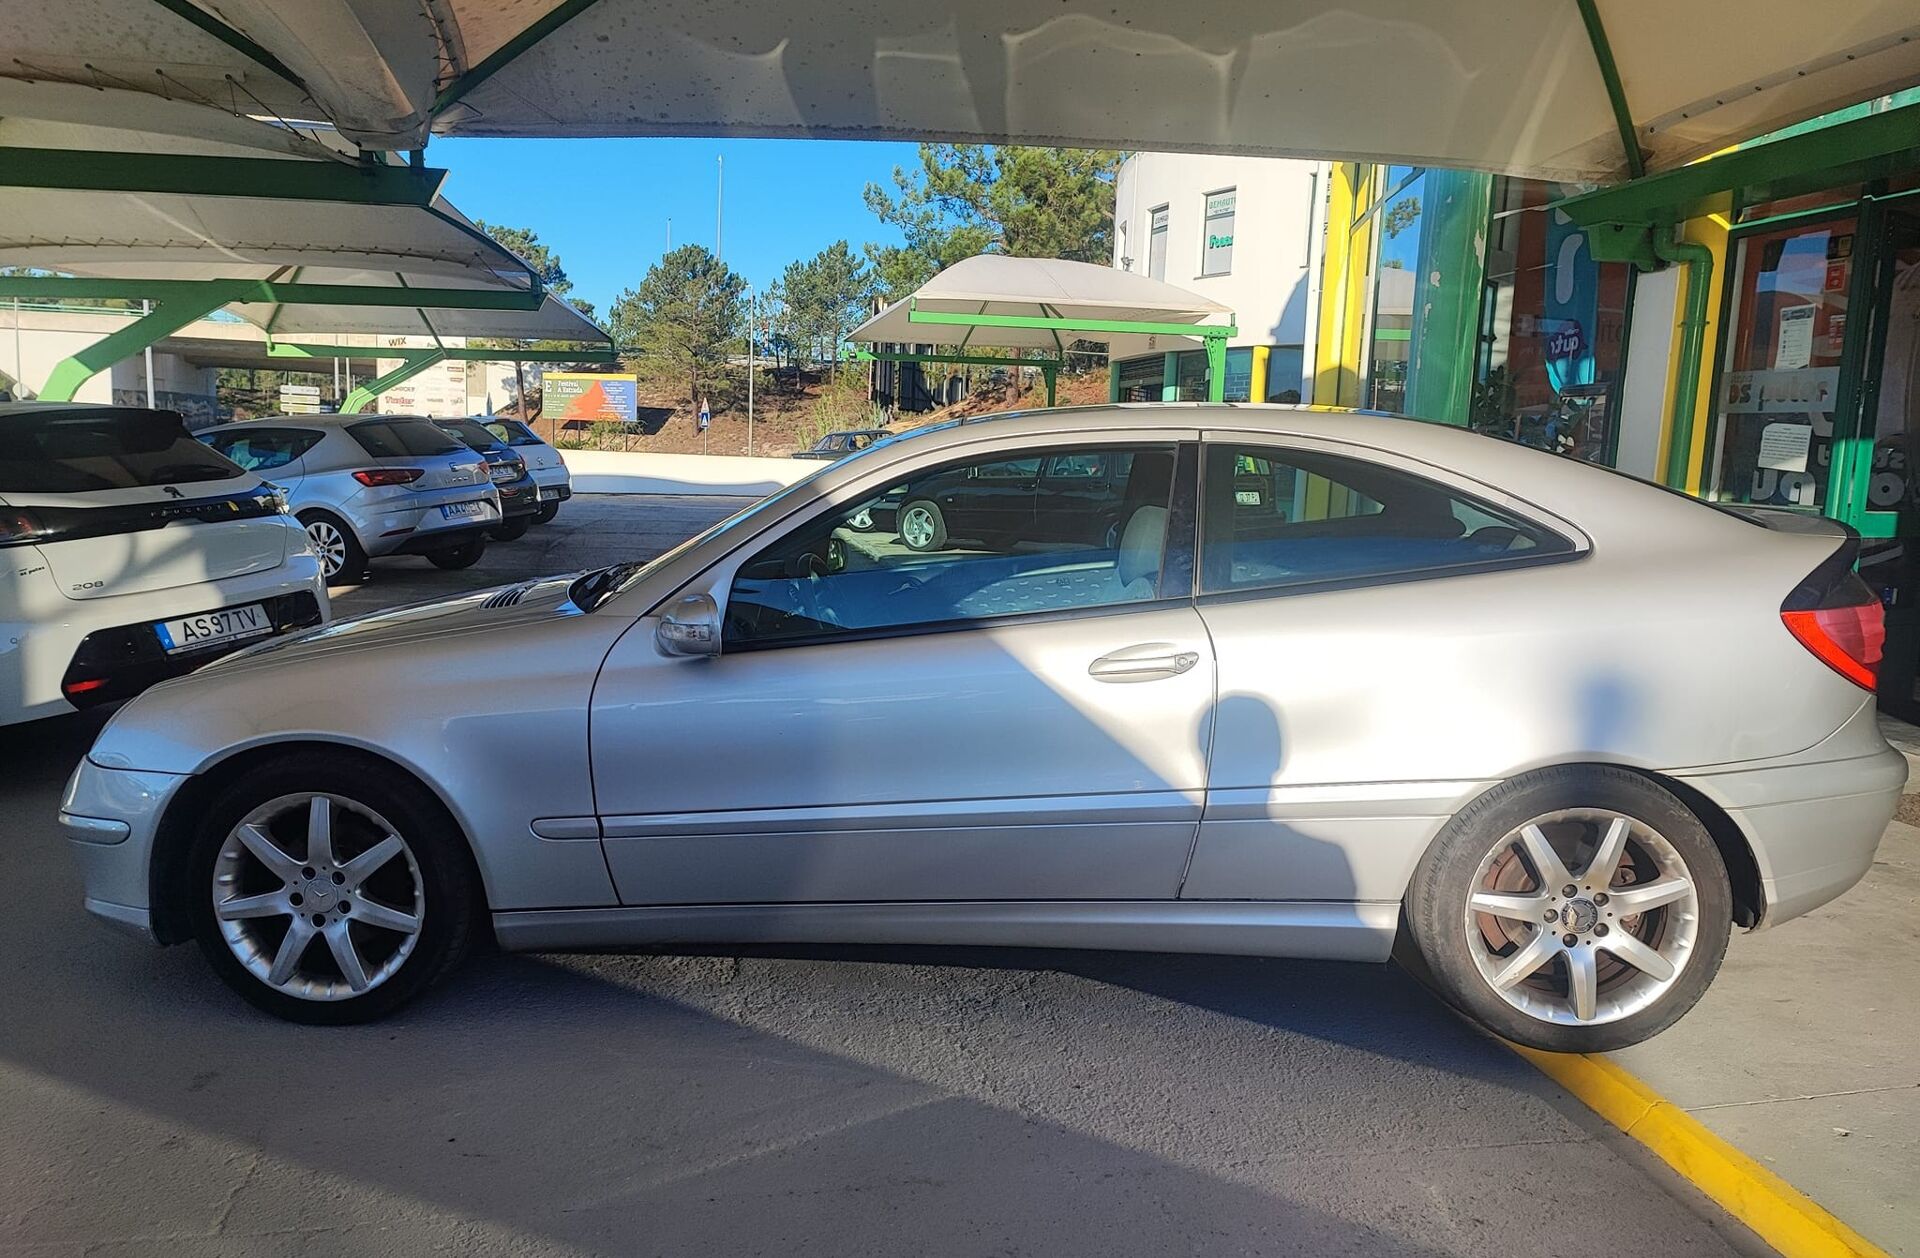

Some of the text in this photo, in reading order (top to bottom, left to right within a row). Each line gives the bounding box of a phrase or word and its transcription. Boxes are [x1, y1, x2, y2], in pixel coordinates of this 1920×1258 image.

[388, 337, 407, 346] WIX
[72, 580, 104, 591] 208
[183, 607, 257, 642] AS97TV
